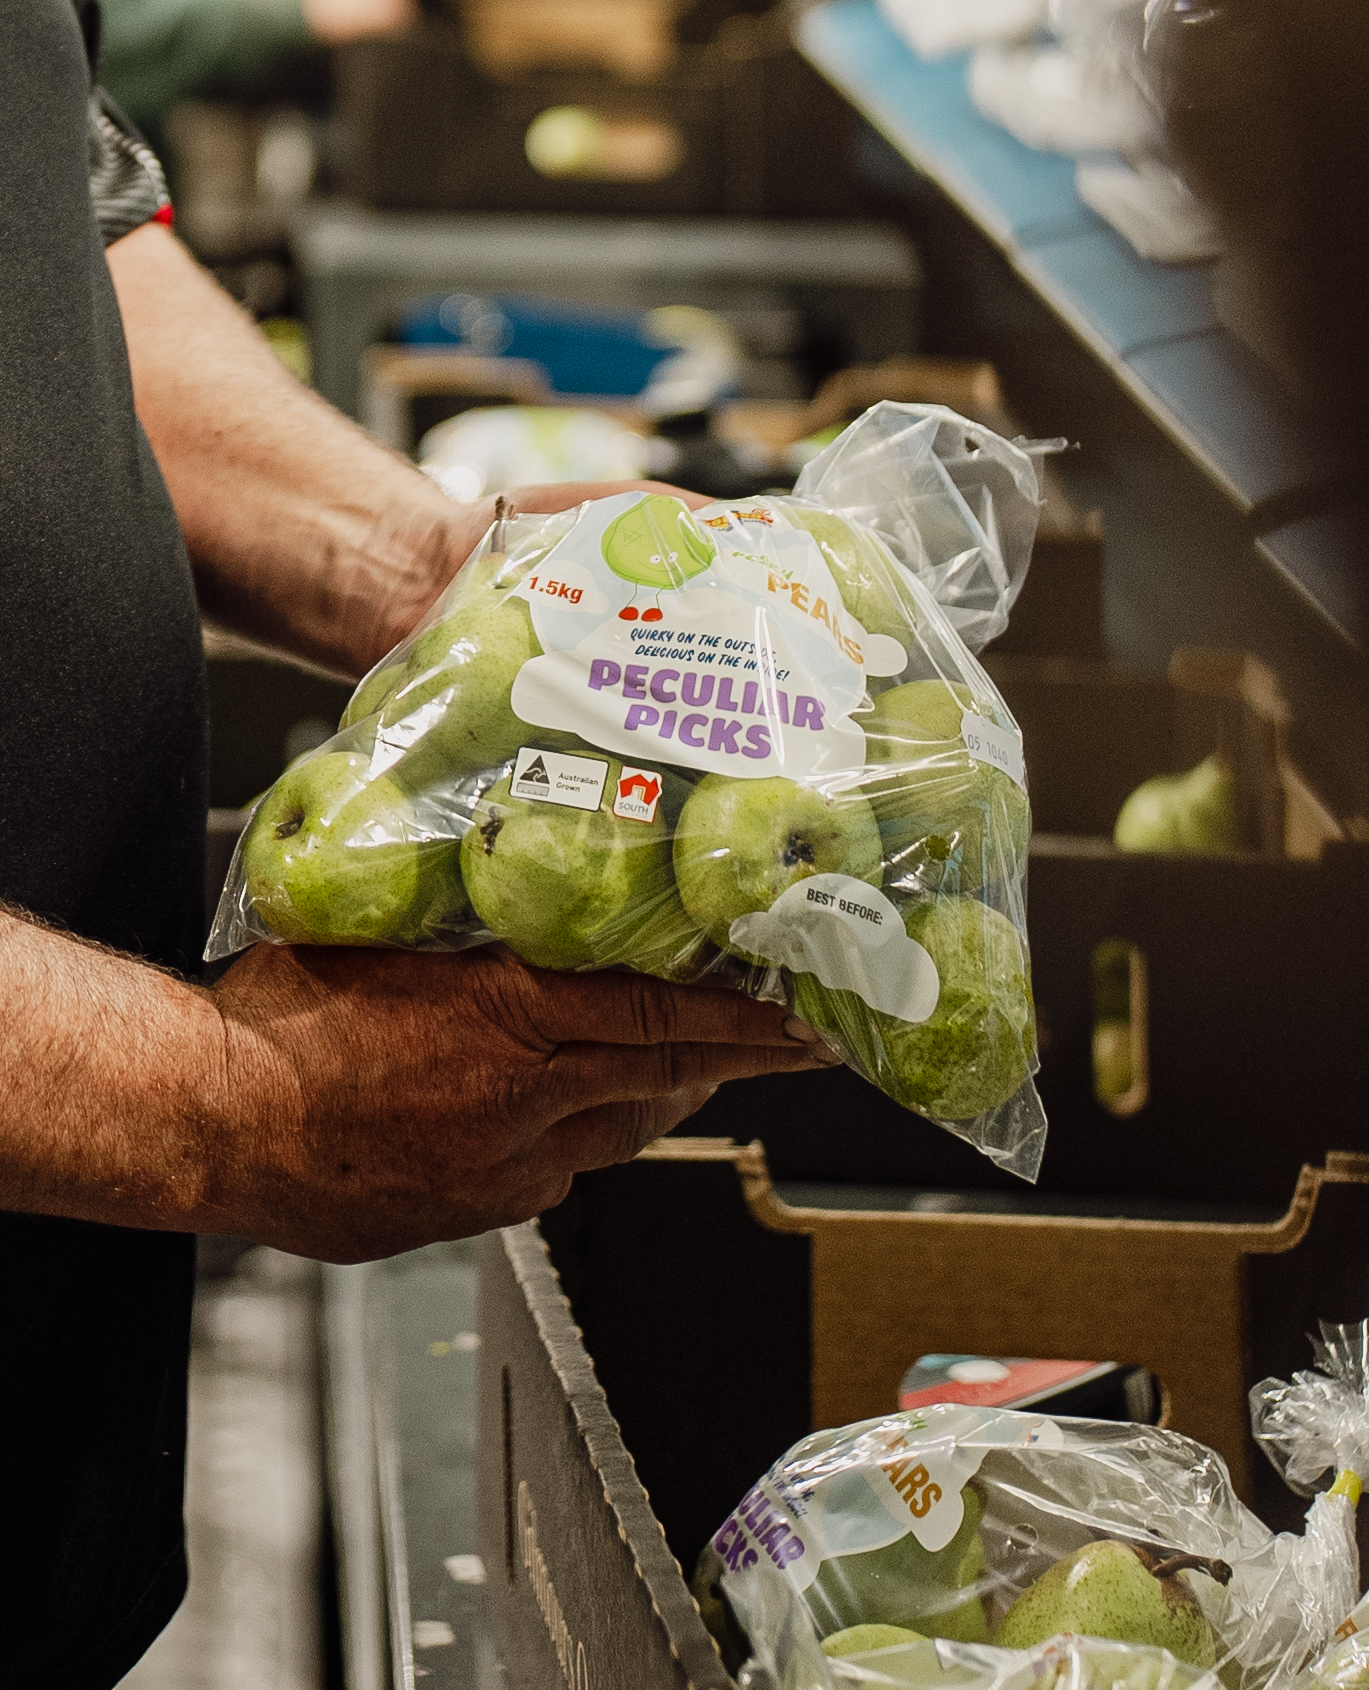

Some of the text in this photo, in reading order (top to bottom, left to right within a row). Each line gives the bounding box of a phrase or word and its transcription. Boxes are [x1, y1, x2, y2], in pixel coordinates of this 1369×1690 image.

[529, 576, 584, 605] 1.5kg
[629, 628, 675, 643] QUIRKY
[677, 632, 696, 645] ON
[698, 634, 723, 648] THE
[634, 644, 695, 662] DELICIOUS
[697, 651, 716, 664] ON
[717, 654, 743, 669] THE
[587, 659, 826, 731] PECULIAR
[623, 704, 772, 759] PICKS
[555, 781, 581, 793] Grown
[557, 772, 599, 786] Australian
[617, 801, 649, 816] SOUTH
[806, 888, 884, 926] BEST BEFORE:
